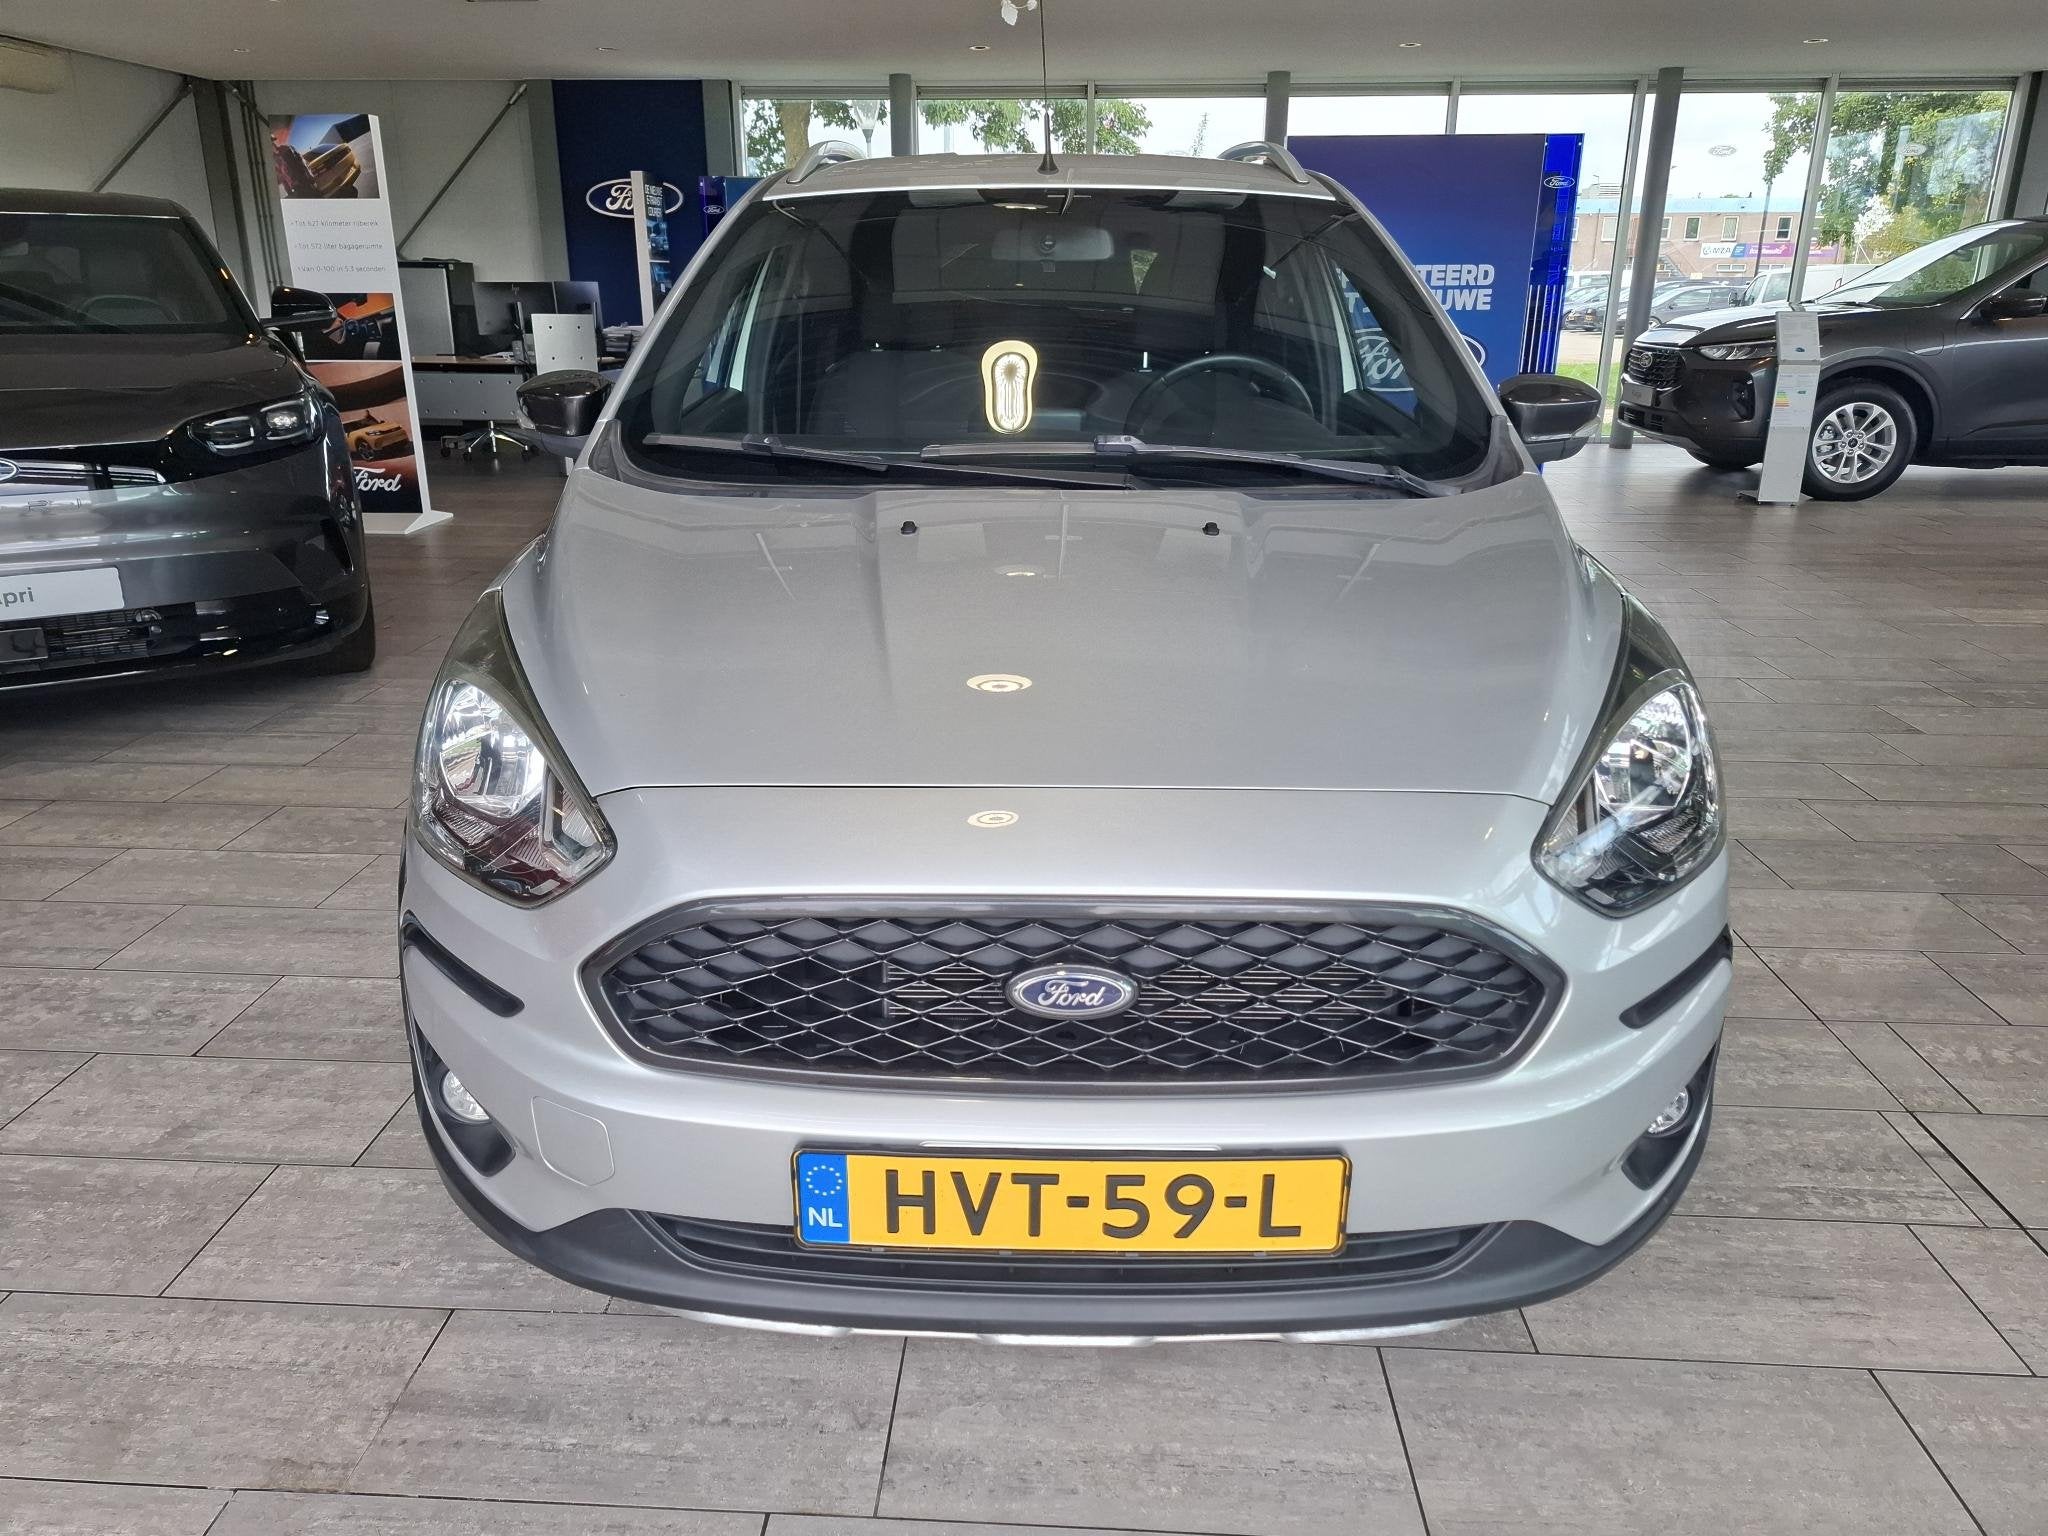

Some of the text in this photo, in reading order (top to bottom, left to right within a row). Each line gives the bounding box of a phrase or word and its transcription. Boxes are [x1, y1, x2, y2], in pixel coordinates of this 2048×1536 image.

[606, 184, 634, 211] Fo
[339, 241, 383, 252] bagageruimte
[1413, 264, 1495, 286] TEERD
[1431, 288, 1493, 311] UWE
[0, 586, 34, 607] pri
[1038, 979, 1106, 1006] Ford
[885, 1169, 1302, 1239] HVT-59-L
[807, 1206, 843, 1228] NL
